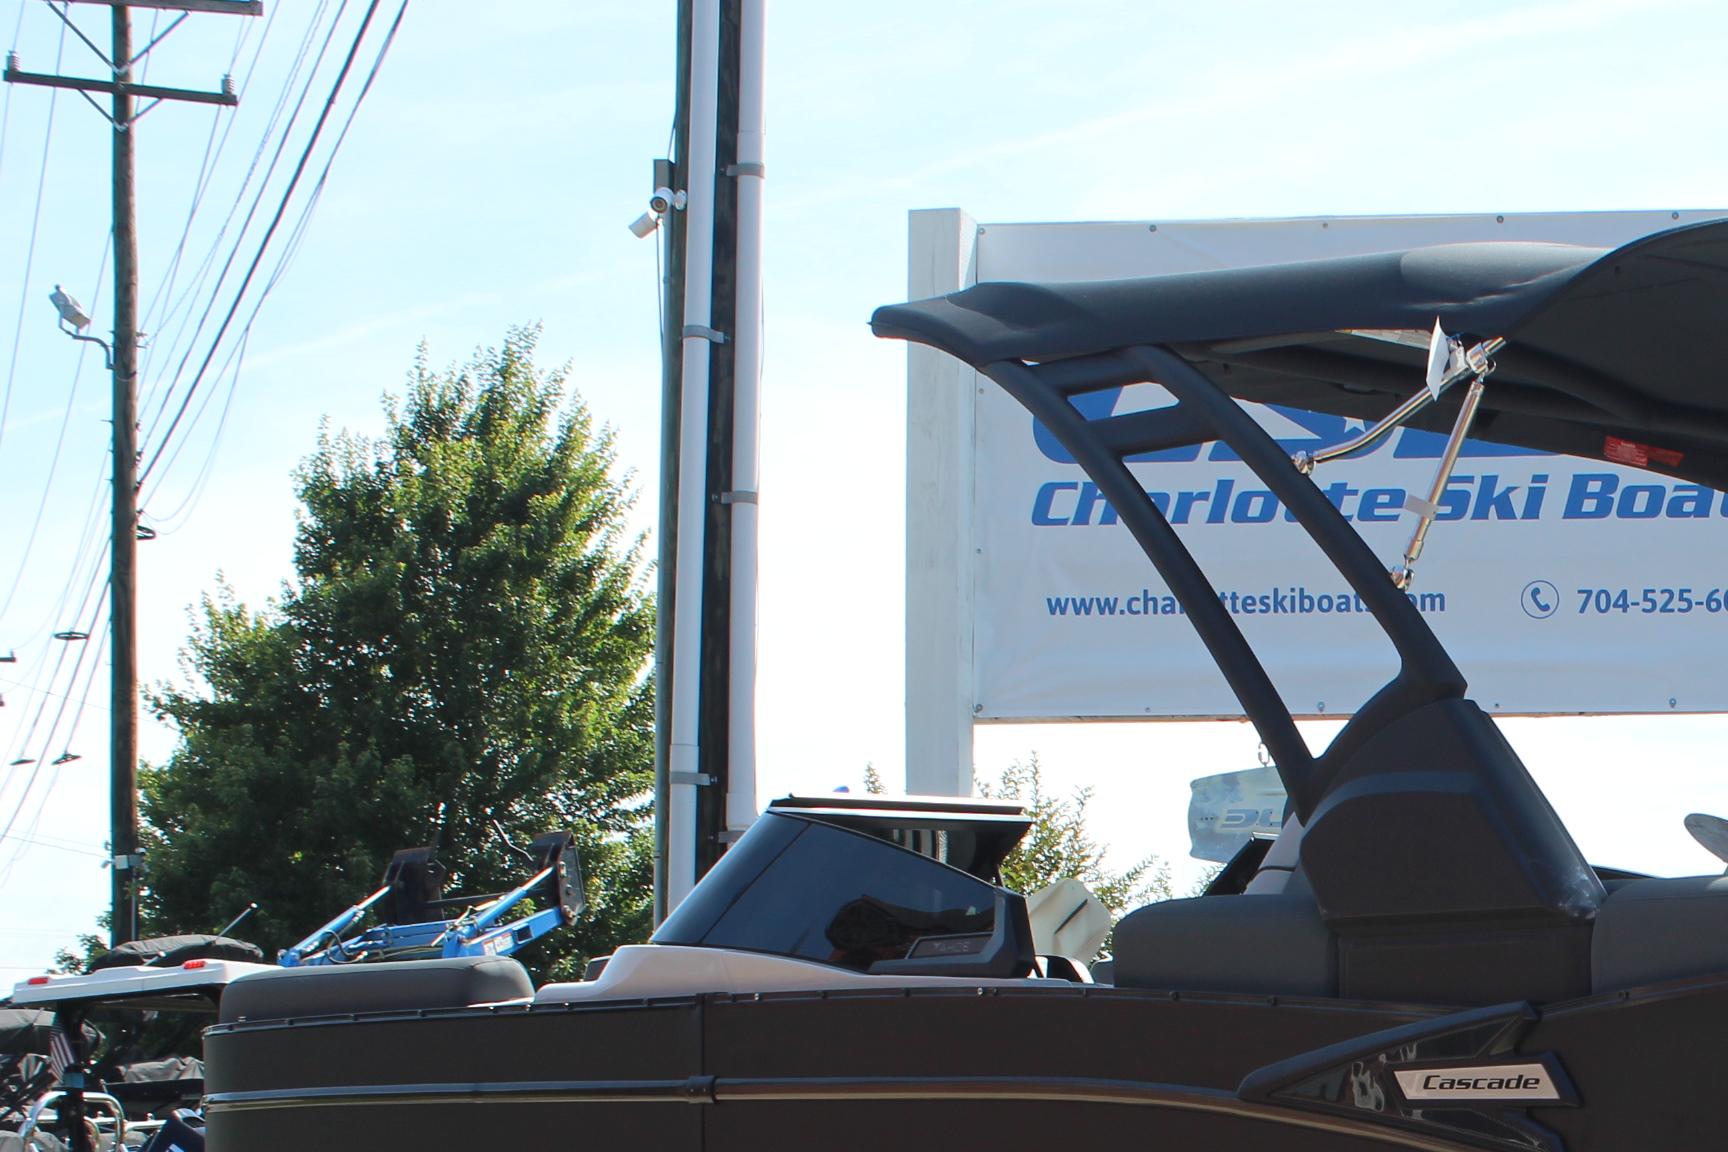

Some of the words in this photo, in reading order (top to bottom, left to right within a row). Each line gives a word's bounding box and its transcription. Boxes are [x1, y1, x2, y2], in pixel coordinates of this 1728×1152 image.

[1031, 478, 1407, 526] Chrlote
[1432, 474, 1550, 522] Ski
[1422, 1074, 1540, 1091] Cascade
